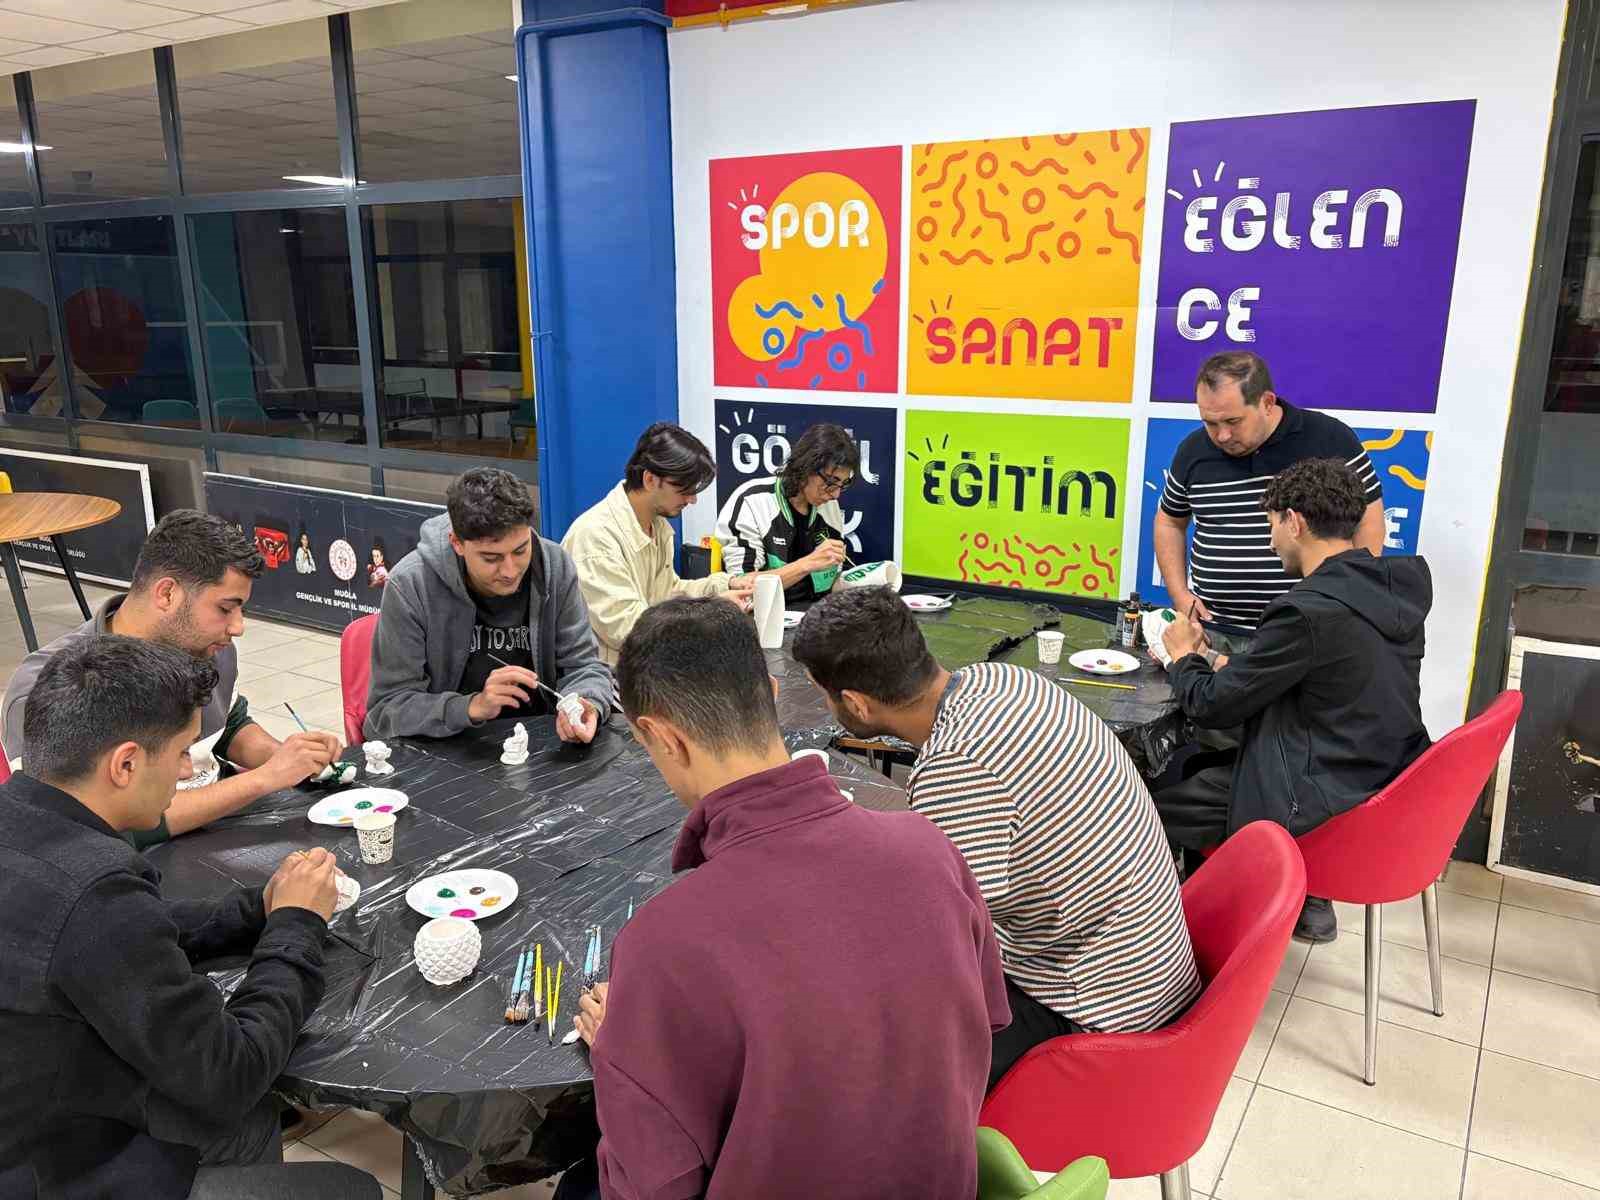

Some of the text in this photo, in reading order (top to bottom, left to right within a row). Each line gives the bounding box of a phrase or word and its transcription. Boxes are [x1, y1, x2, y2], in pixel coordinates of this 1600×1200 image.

[739, 199, 871, 251] SPOR
[1182, 176, 1404, 253] EĞLEN
[1175, 287, 1261, 342] CE
[924, 316, 1123, 368] SANAT
[731, 424, 880, 486] GÖL
[922, 451, 1118, 519] EĞİTİM
[296, 591, 323, 604] GENÇLİK
[323, 598, 332, 606] VE
[333, 599, 350, 609] SPOR
[358, 604, 381, 615] MÜDÜR
[334, 589, 357, 600] MUĞLA
[485, 627, 505, 650] TO
[505, 625, 530, 652] STAR
